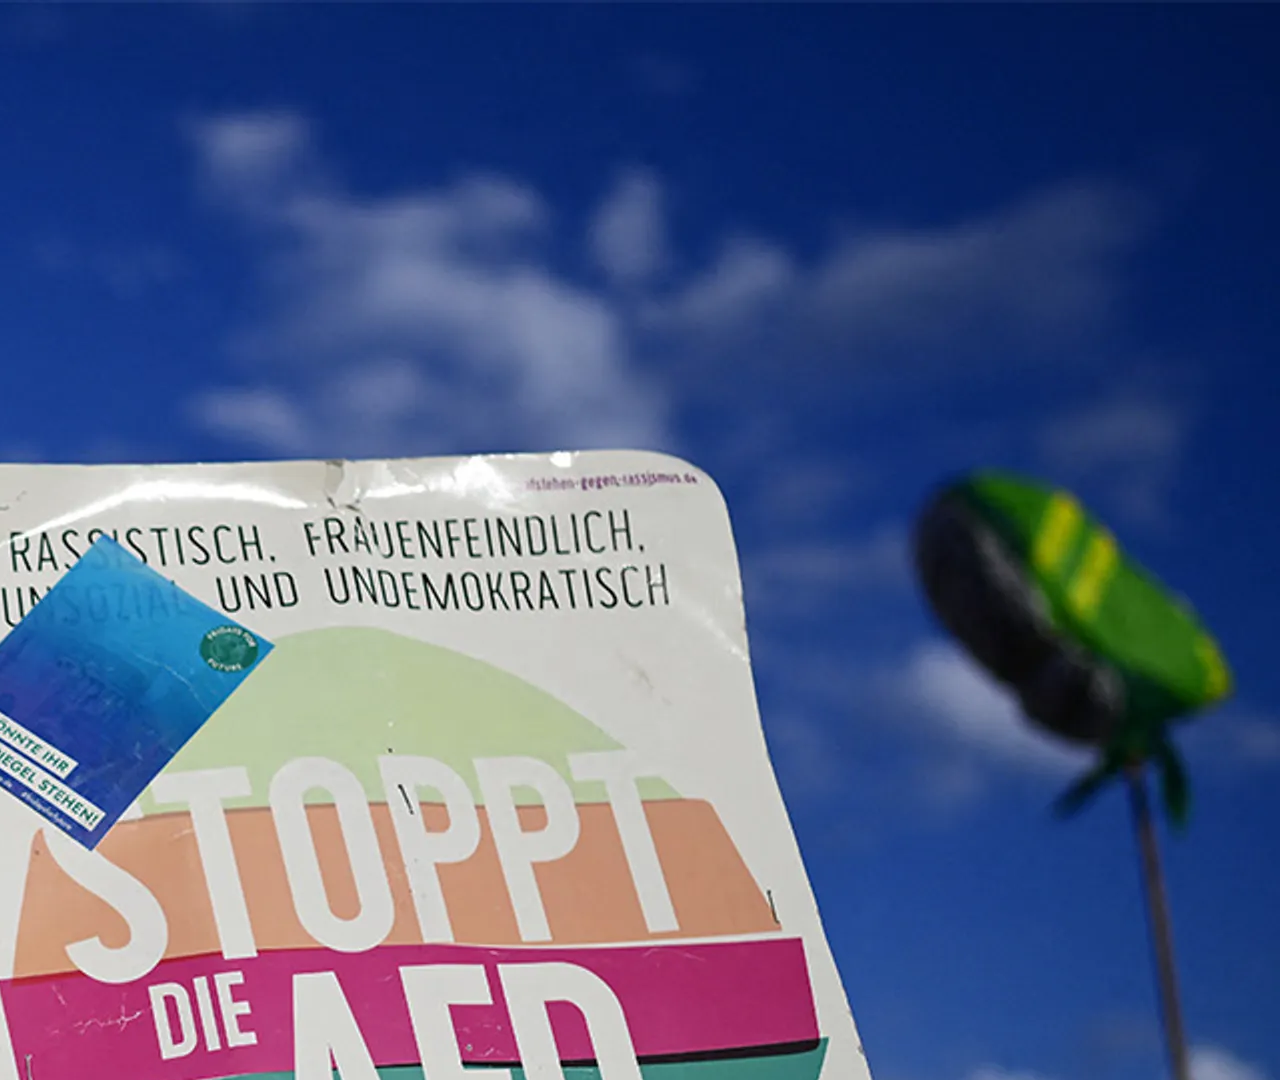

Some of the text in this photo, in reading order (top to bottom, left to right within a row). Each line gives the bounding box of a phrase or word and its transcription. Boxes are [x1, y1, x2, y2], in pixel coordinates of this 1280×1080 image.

[215, 571, 299, 613] UND
[323, 564, 670, 612] UNDEMOKRATISCH
[43, 751, 70, 773] IHR
[38, 779, 100, 826] STEHEN!
[40, 751, 678, 984] STOPPT
[148, 970, 258, 1062] DIE
